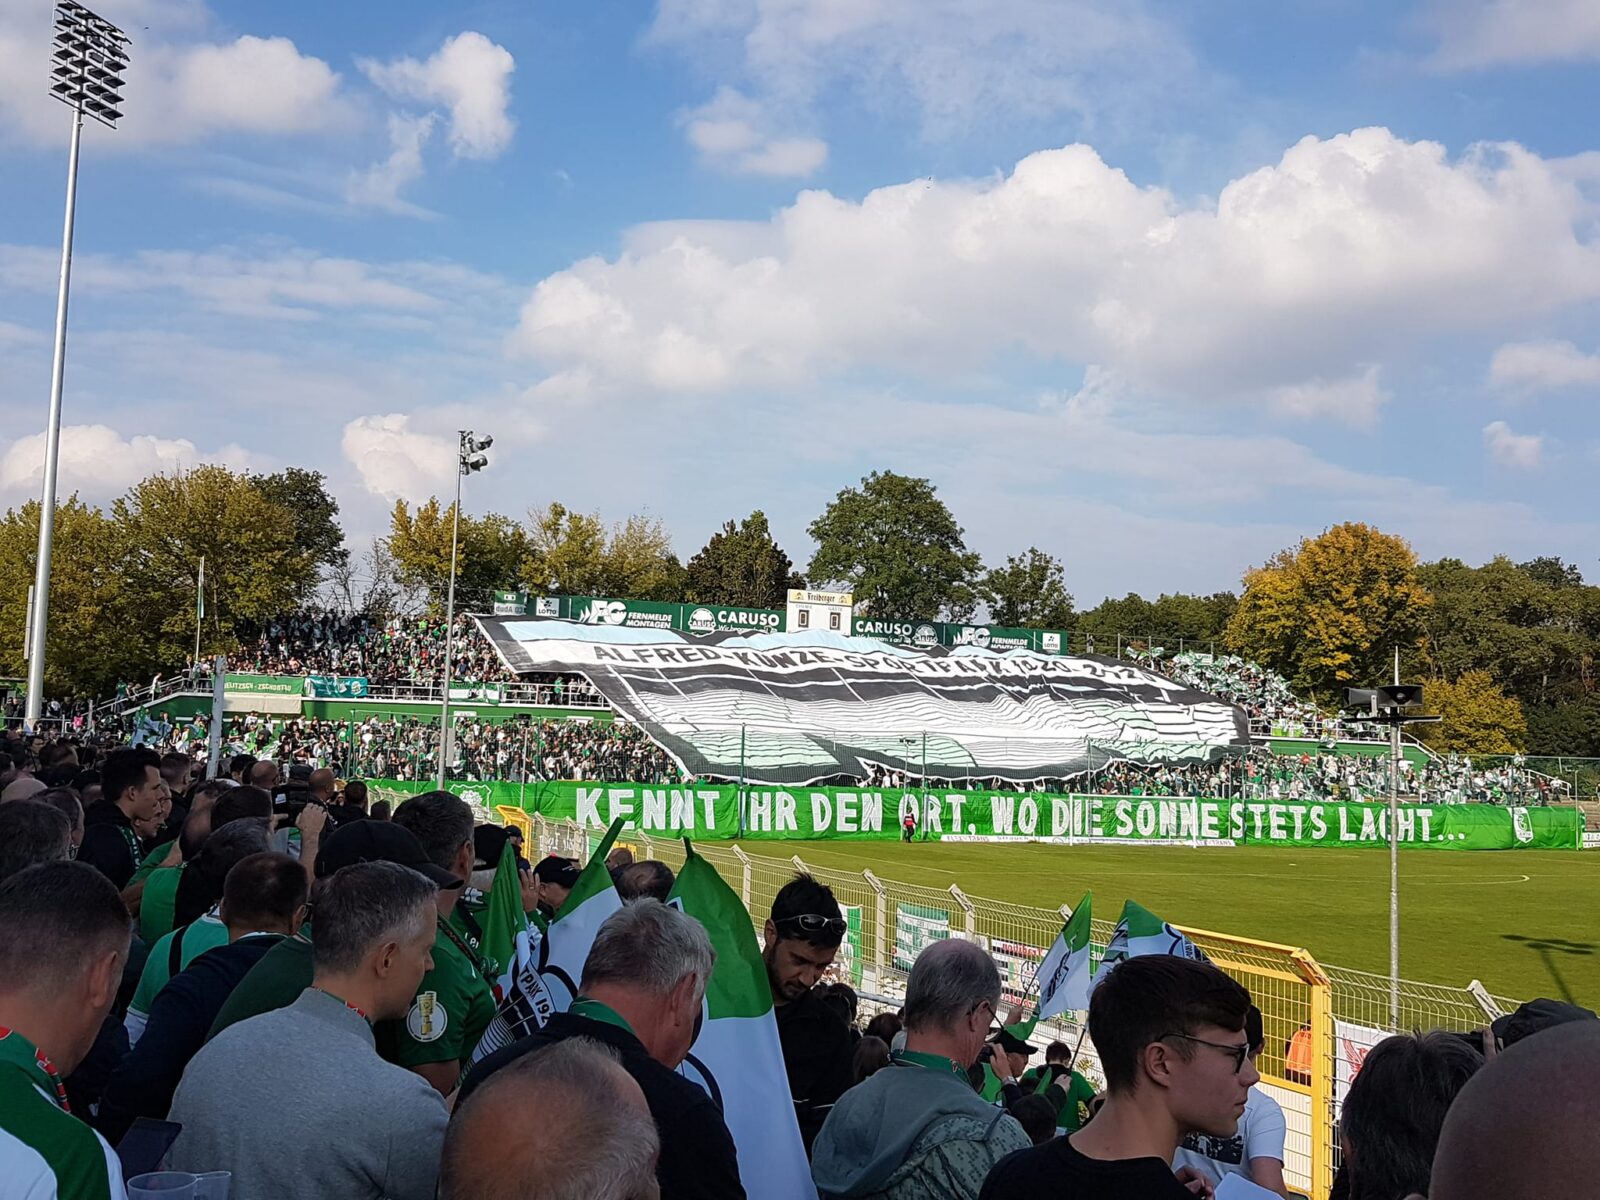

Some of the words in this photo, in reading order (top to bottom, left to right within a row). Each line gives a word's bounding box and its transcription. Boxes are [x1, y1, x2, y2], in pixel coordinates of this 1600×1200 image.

[807, 592, 836, 602] Freiberger
[628, 612, 673, 621] FERNMELDE
[717, 610, 780, 626] CARUSO
[626, 621, 672, 629] MONTAGEN
[855, 620, 913, 635] CARUSO
[991, 637, 1028, 645] FERNMELDE
[576, 787, 720, 830] KENNT
[737, 790, 798, 831] IHR
[810, 792, 883, 832] DEN
[898, 794, 977, 836] ORT,
[990, 796, 1038, 835] WO
[1052, 799, 1104, 837] DIE
[1115, 800, 1220, 839] SONNE
[1231, 803, 1328, 841] STETS
